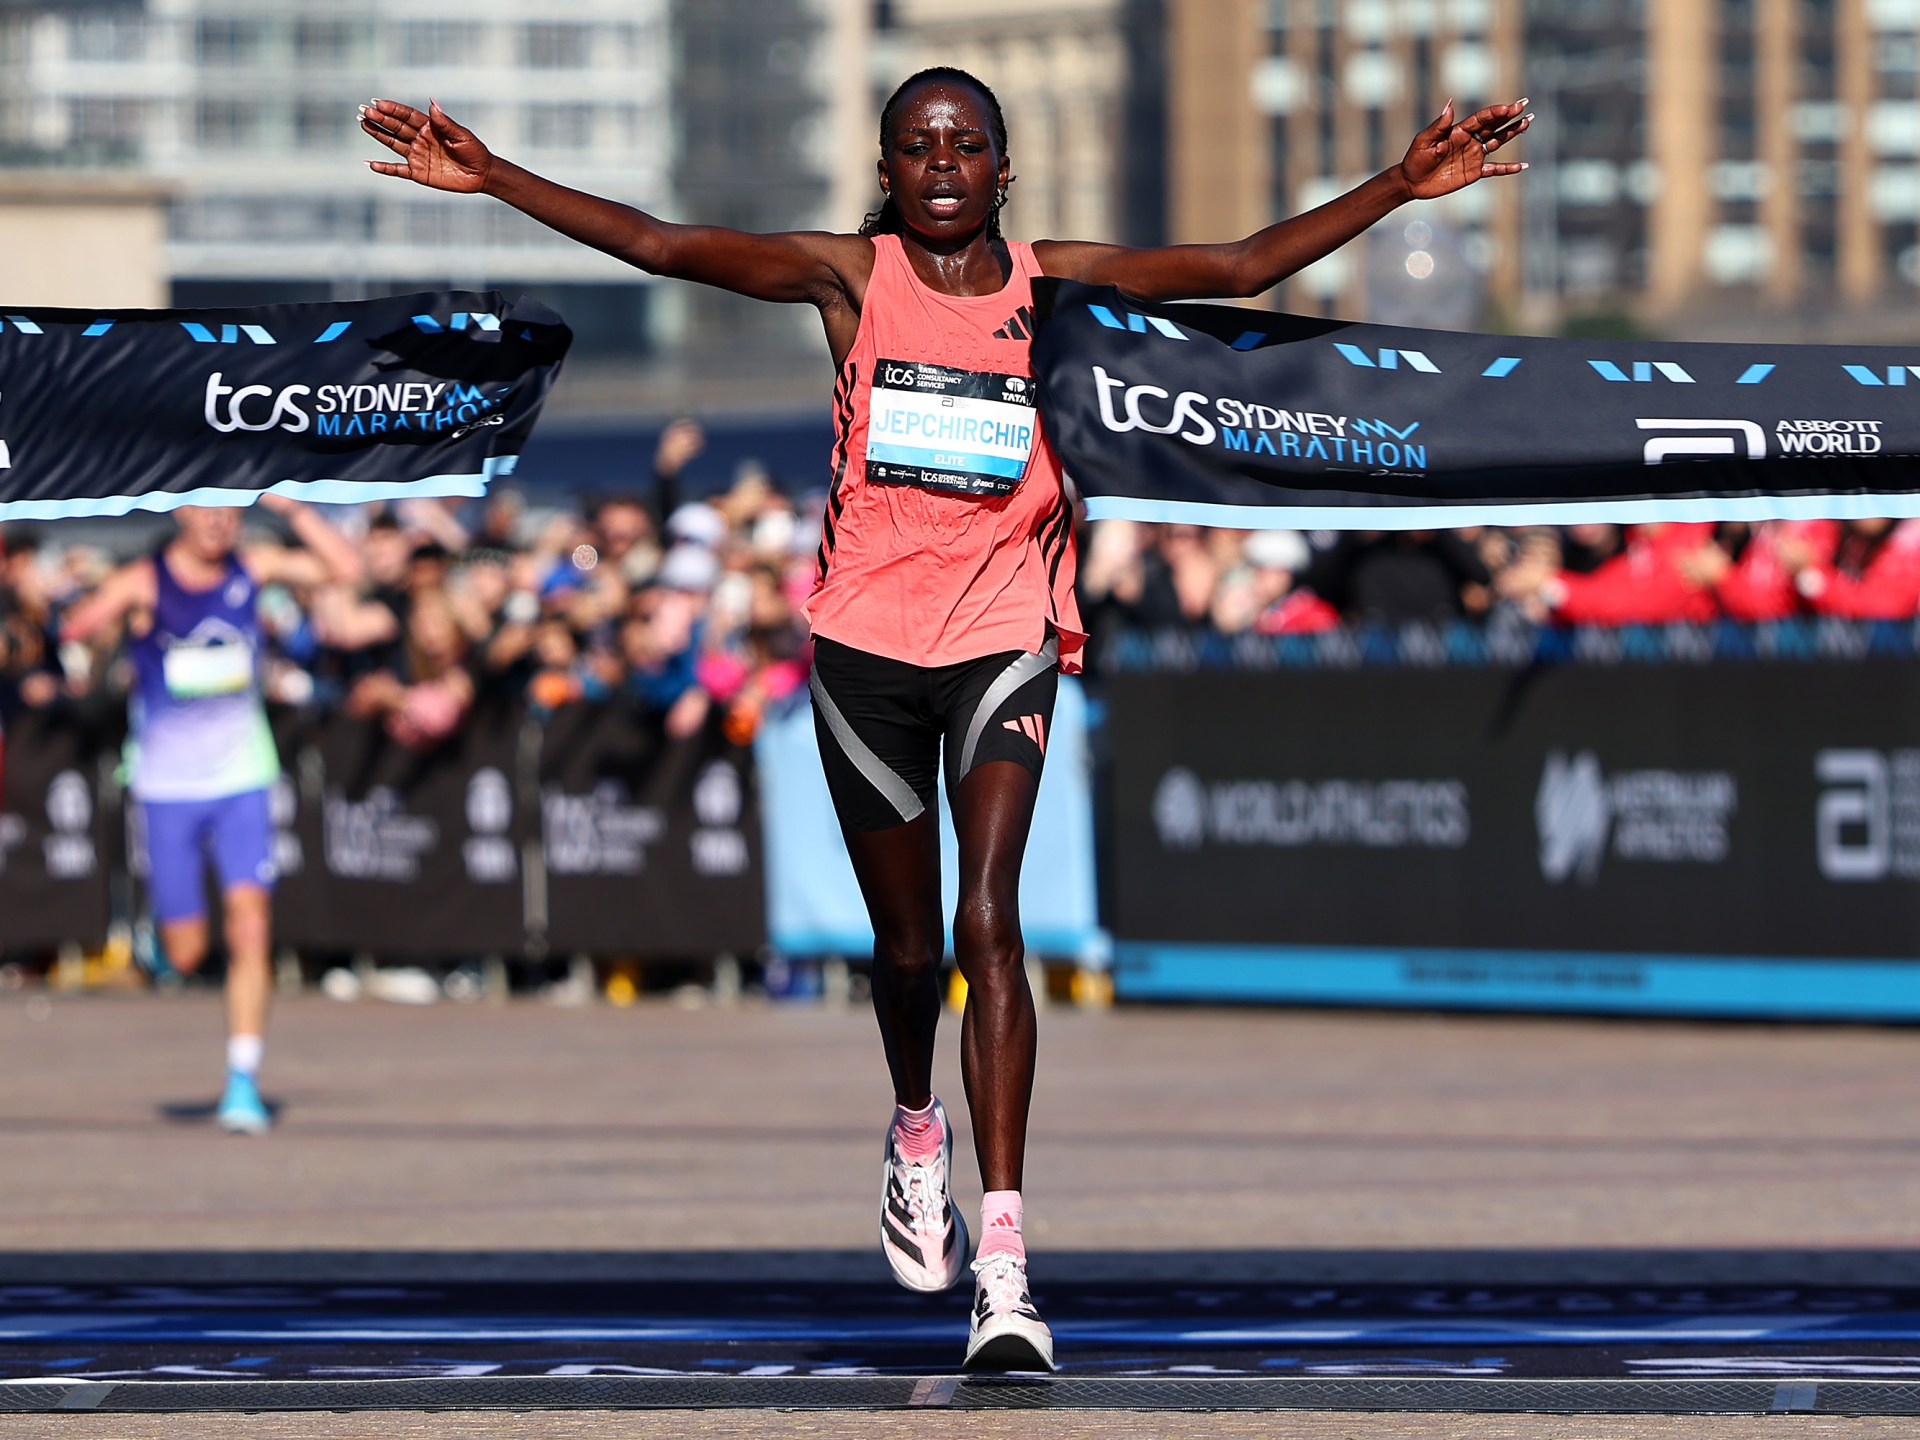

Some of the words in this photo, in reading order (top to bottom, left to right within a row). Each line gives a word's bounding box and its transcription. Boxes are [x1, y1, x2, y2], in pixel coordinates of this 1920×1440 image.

[885, 363, 914, 386] tcs
[916, 373, 963, 385] CONSULTANCY
[918, 364, 938, 375] TATA
[916, 380, 946, 390] SERVICES
[205, 372, 311, 433] tcs
[315, 383, 446, 413] SYDNEY
[1001, 392, 1027, 405] TATA
[1092, 366, 1217, 445] tcs
[1216, 398, 1348, 437] SYDNEY
[317, 400, 492, 436] MARATHO
[1775, 420, 1883, 433] ABBOTT
[875, 409, 1031, 450] JEPCHIRCHIR
[1222, 427, 1427, 469] MARATHON
[1775, 433, 1882, 453] WORLD
[934, 453, 965, 467] ELITE
